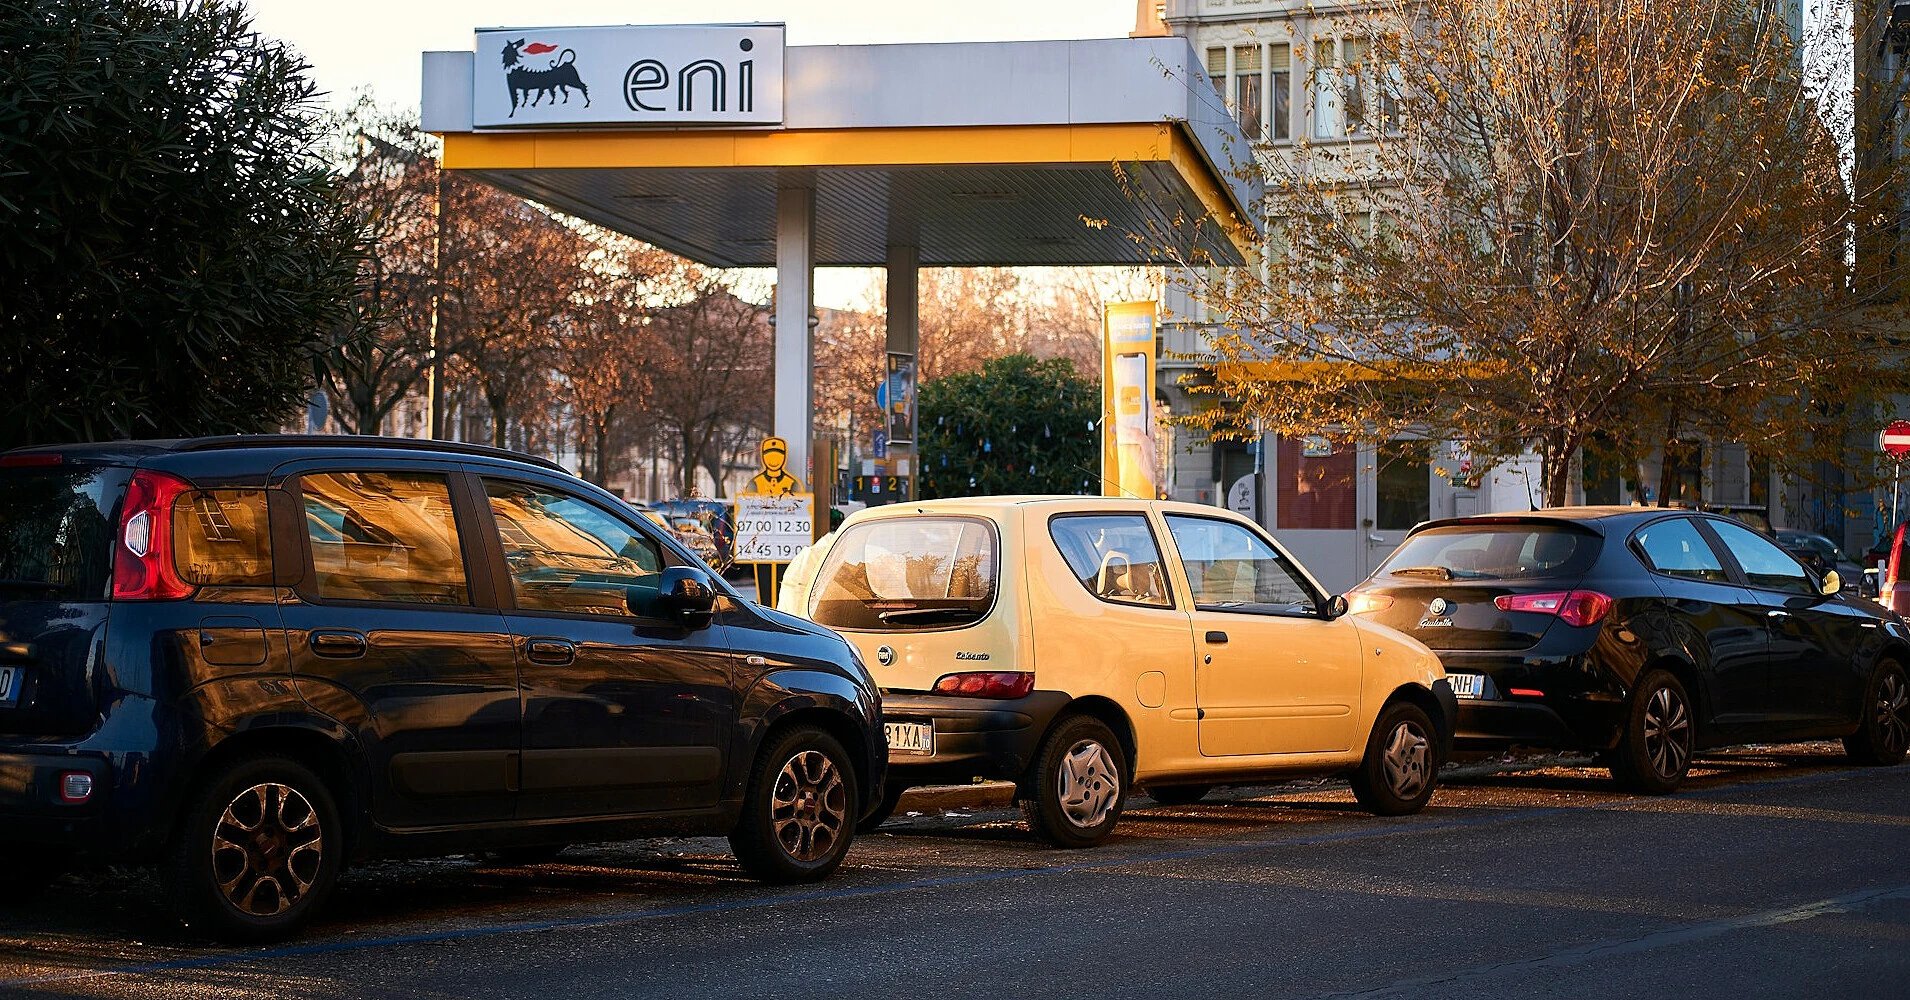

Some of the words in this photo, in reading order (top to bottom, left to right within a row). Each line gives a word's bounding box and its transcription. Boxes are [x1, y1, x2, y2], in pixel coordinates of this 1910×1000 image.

[623, 38, 753, 112] eni
[856, 477, 864, 491] 1
[888, 477, 897, 491] 2
[1447, 676, 1473, 692] NH
